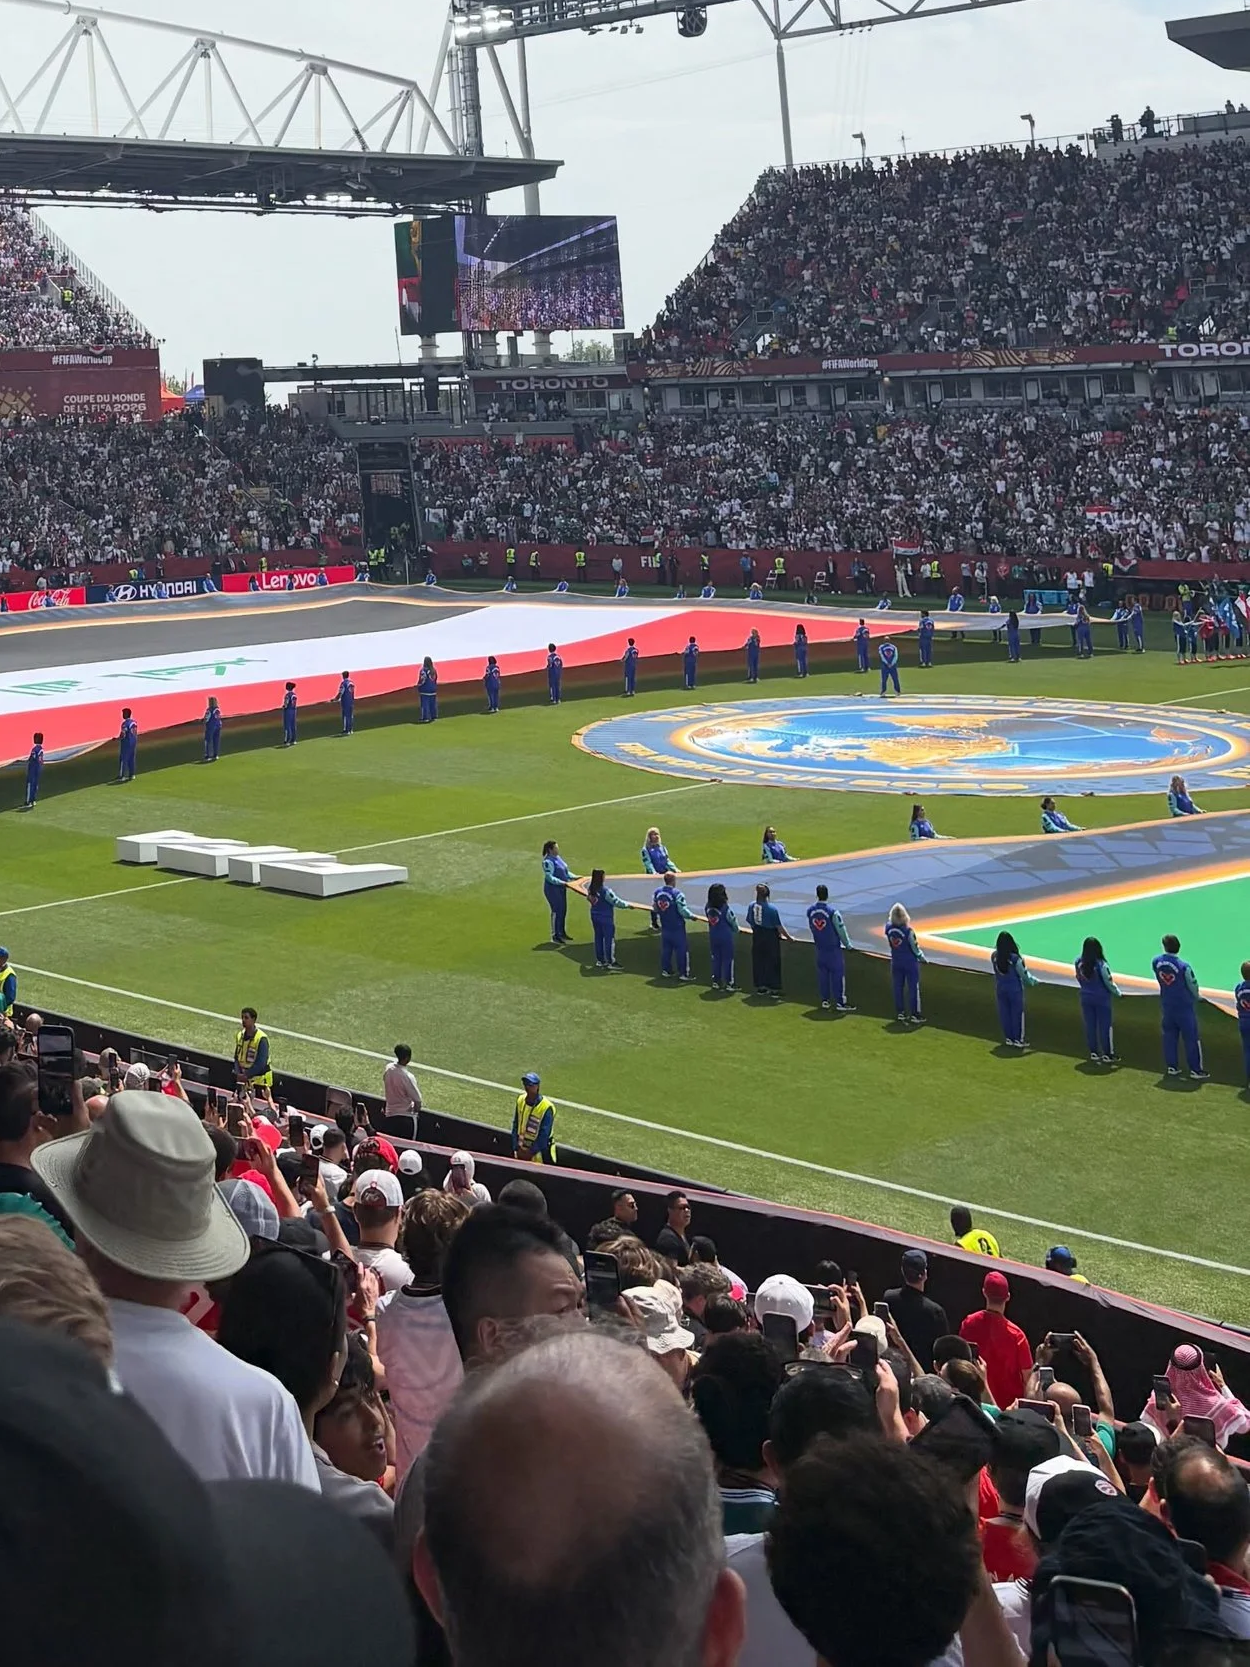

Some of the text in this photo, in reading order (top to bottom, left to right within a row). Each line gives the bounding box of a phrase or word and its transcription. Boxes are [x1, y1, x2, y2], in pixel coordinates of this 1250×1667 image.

[496, 376, 609, 391] TORONTO
[63, 394, 145, 403] COUPE DU MONDE
[140, 580, 197, 598] HYNDAI
